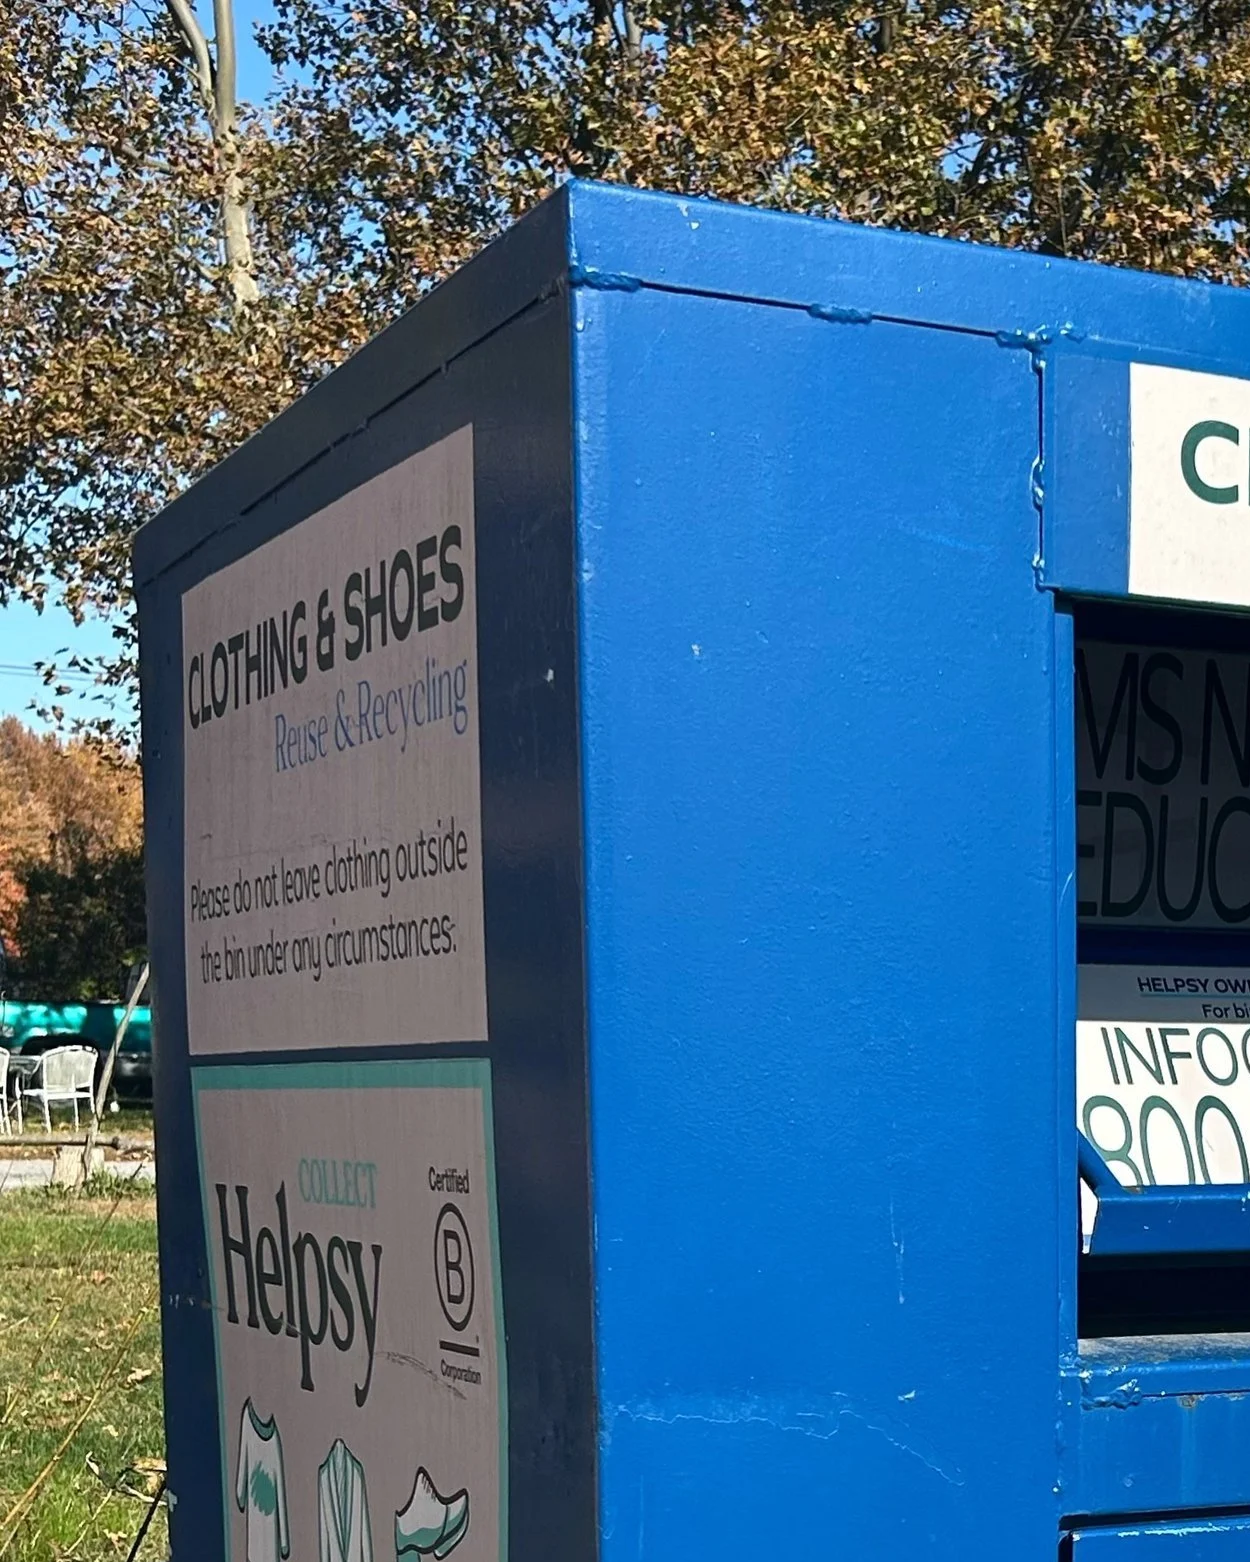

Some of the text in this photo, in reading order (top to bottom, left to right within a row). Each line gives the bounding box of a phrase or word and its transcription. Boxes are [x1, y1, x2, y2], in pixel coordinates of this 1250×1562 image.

[188, 524, 464, 730] CLOTHING & SHOES
[274, 655, 468, 773] Reuse & Recycling
[190, 816, 468, 923] Please do not leave clothing outside
[200, 940, 222, 984] the
[224, 934, 246, 981] bin
[247, 929, 289, 979] under
[292, 935, 322, 983] any
[1137, 976, 1211, 994] HELPSY
[1201, 1003, 1231, 1020] For
[298, 1156, 378, 1210] COLLECT
[428, 1166, 471, 1195] Certified
[215, 1179, 383, 1408] Helpsy
[440, 1359, 482, 1386] Corporation
